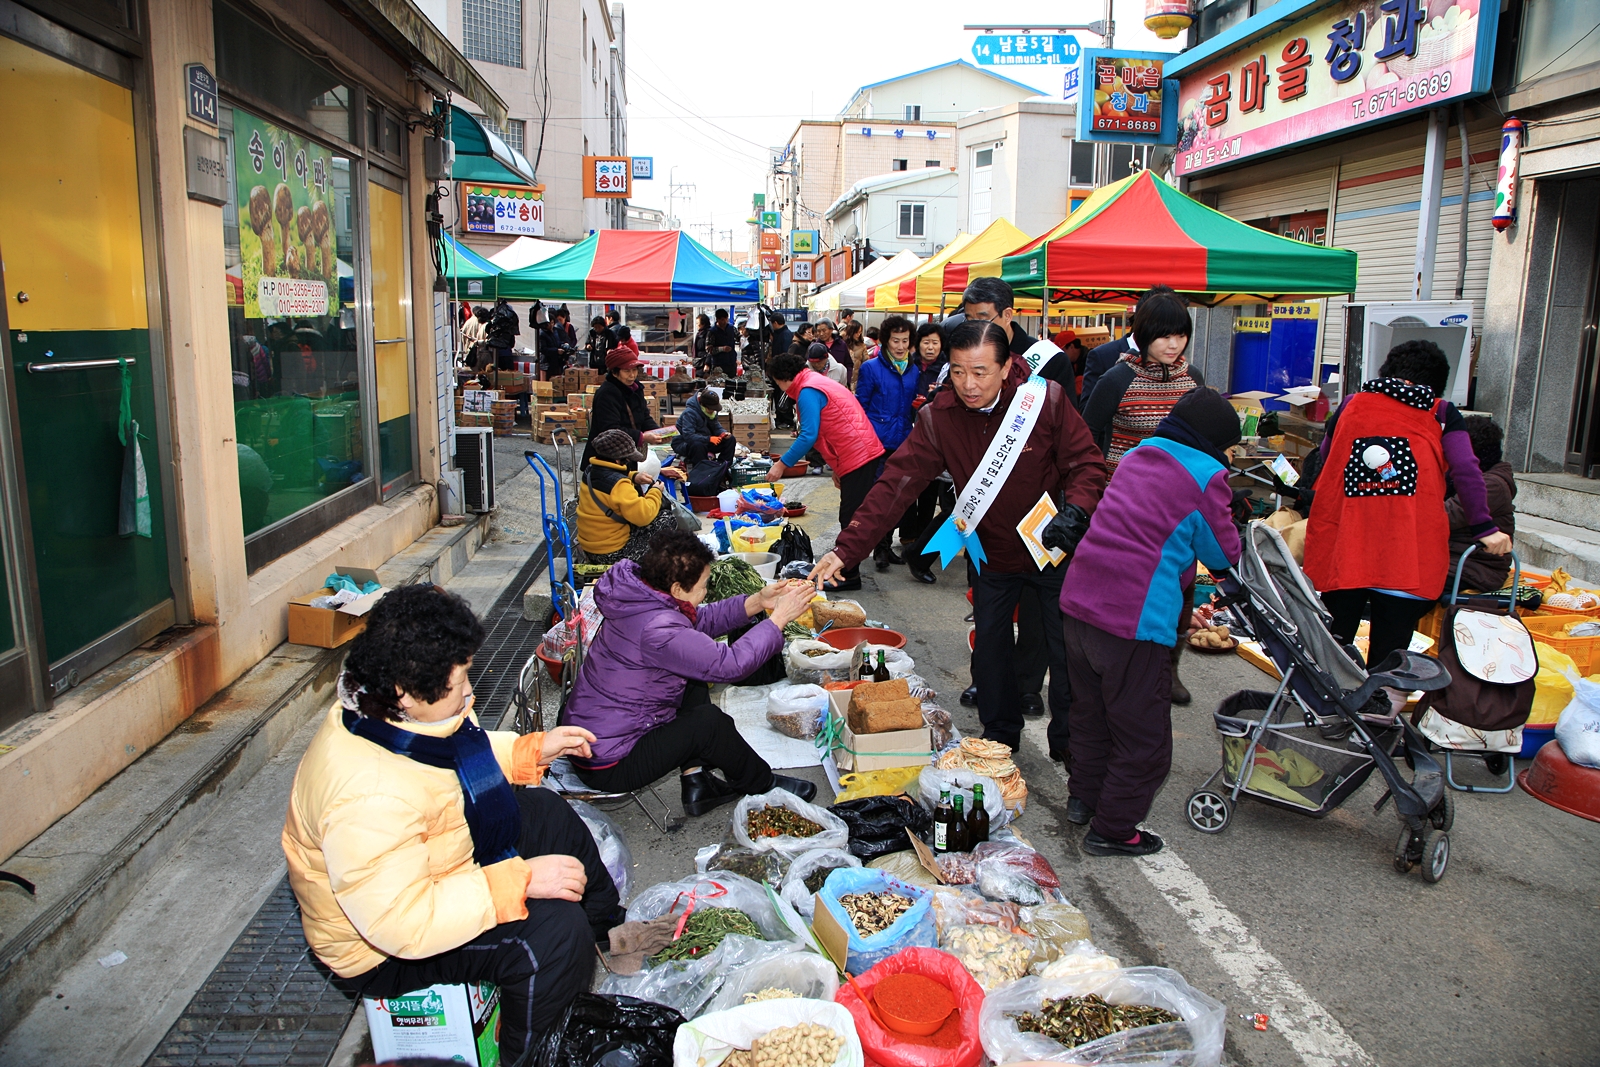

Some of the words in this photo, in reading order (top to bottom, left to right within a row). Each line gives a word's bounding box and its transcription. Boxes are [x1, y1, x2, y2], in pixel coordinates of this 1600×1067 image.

[975, 44, 990, 56] 14
[999, 36, 1054, 53] 남문5길
[1063, 43, 1077, 56] 10
[1205, 37, 1313, 128] 곰마을
[1325, 0, 1427, 84] 청과
[1097, 64, 1160, 88] 곰마을
[1368, 70, 1452, 115] 671-8689
[193, 90, 215, 120] 11-4
[1109, 91, 1150, 114] 청과
[1097, 118, 1158, 131] 671-8689
[248, 129, 327, 194] 송이아빠
[1184, 148, 1203, 171] 과일
[599, 164, 623, 174] 송산
[598, 175, 625, 189] 송이
[495, 201, 517, 219] 송산
[519, 202, 542, 223] 송이
[500, 224, 536, 233] 672-4983
[277, 282, 325, 299] 010-3256-2307
[278, 298, 325, 315] 010-9596-2307
[1442, 316, 1466, 325] SAMSUNG
[986, 434, 1018, 478] 당신이라면
[980, 477, 994, 489] 할
[974, 487, 986, 497] 수
[961, 495, 981, 520] 있습니다
[389, 1000, 421, 1012] 양지뜰
